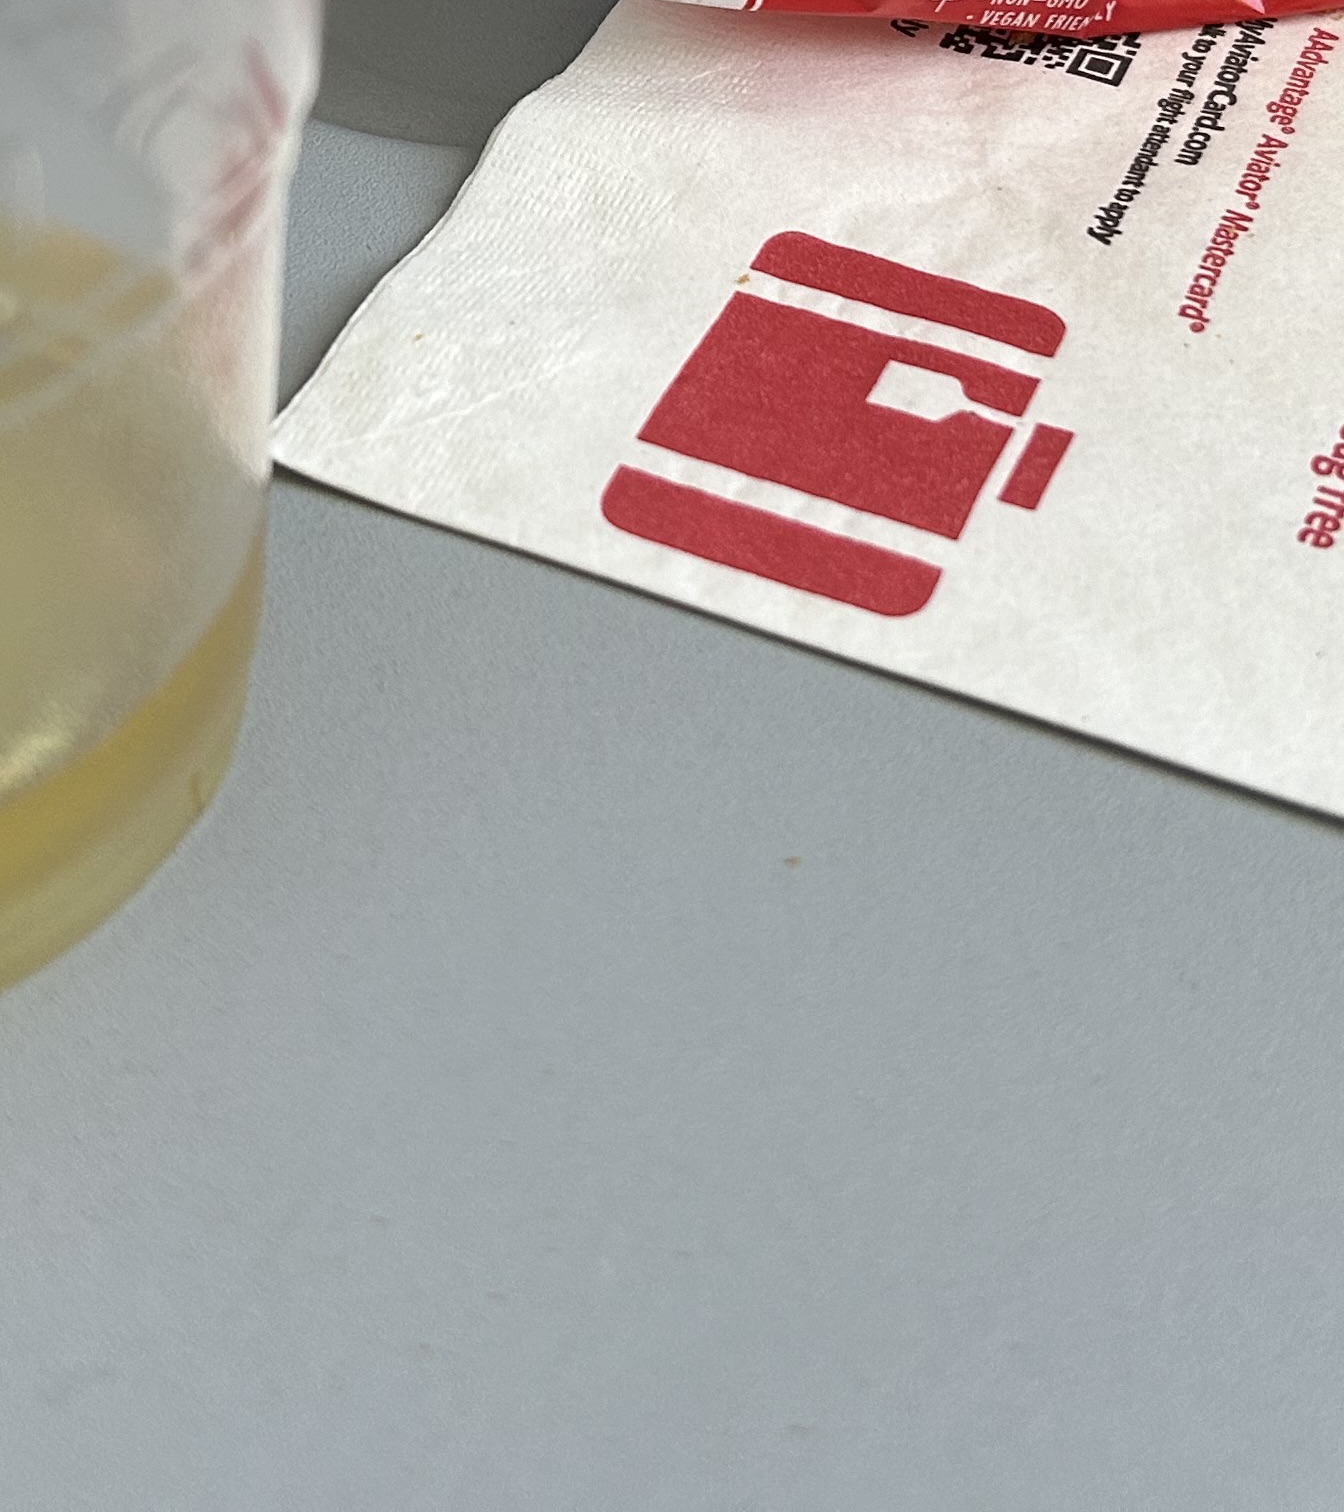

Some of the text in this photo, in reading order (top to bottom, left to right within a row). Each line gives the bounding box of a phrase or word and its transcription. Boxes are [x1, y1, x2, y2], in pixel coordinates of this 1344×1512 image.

[980, 10, 1040, 29] VEGAN
[1191, 37, 1218, 55] to
[1176, 52, 1207, 88] your
[1157, 88, 1196, 125] flight
[1121, 124, 1171, 187] attendant
[1114, 187, 1141, 203] to
[1086, 202, 1129, 246] apply
